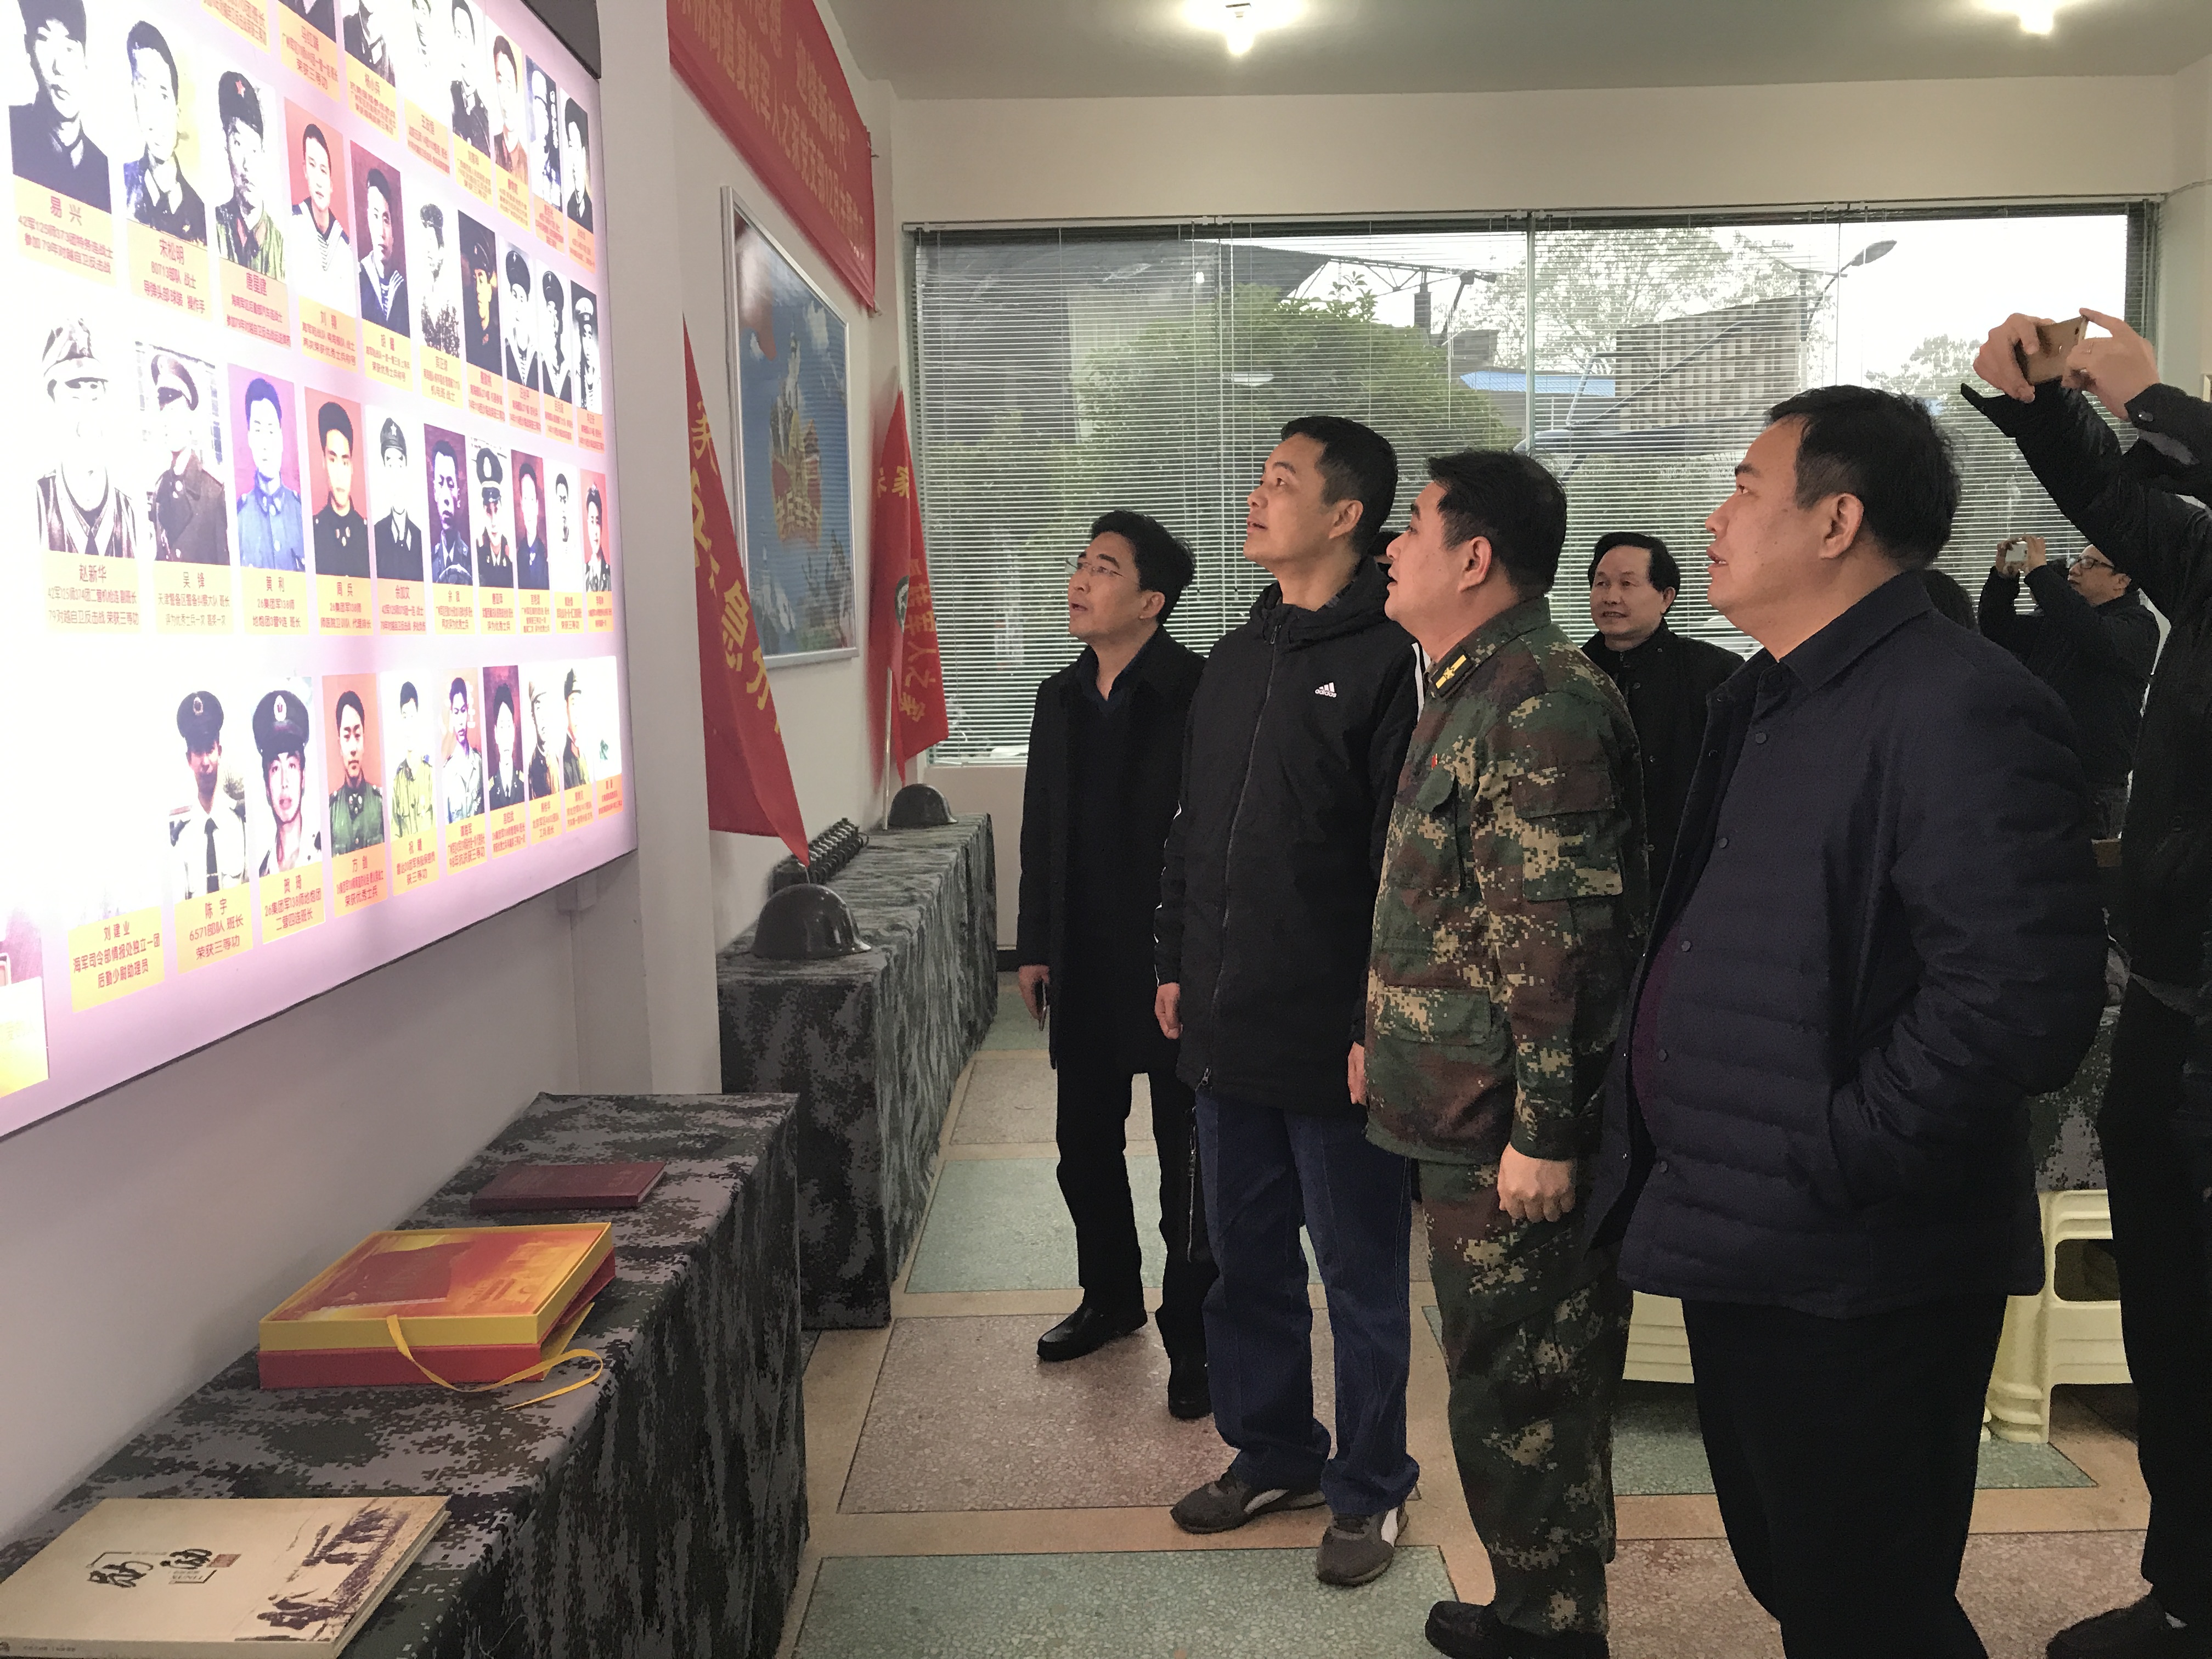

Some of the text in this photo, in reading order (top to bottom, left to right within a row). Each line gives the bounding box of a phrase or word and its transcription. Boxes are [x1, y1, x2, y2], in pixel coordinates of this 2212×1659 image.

[79, 563, 106, 583] 赵新华
[106, 611, 139, 625] 荣获三等功
[1314, 689, 1337, 698] adidas
[407, 868, 427, 885] 获三等功
[345, 884, 377, 907] 荣获优秀士兵
[205, 896, 227, 920] 陈宇
[275, 906, 313, 931] 二营四连班长
[103, 919, 130, 941] 刘建业
[189, 913, 244, 943] 6571部队 班长
[73, 932, 160, 973] 海军司令部情报处独立一团
[195, 933, 240, 961] 荣获三等功
[97, 958, 148, 989] 后勤少尉助理员
